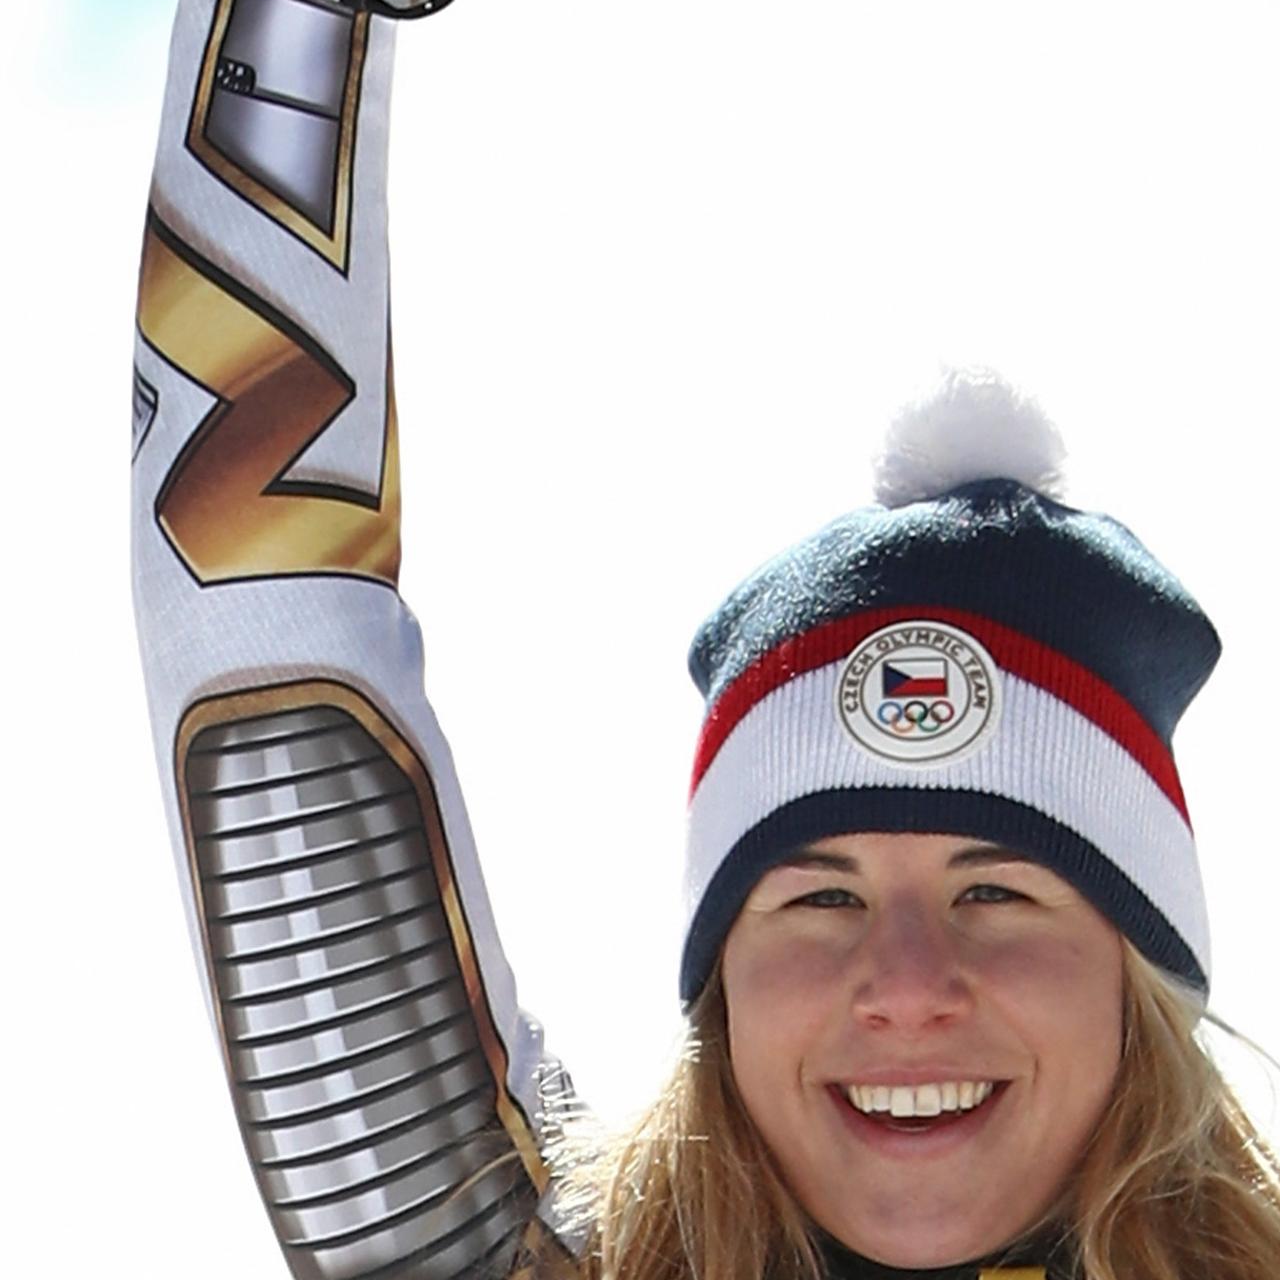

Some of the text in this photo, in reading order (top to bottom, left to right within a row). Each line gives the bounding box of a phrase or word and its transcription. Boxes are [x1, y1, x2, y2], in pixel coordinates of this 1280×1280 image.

[843, 630, 988, 714] CZECH OLYMPIC TEAM
